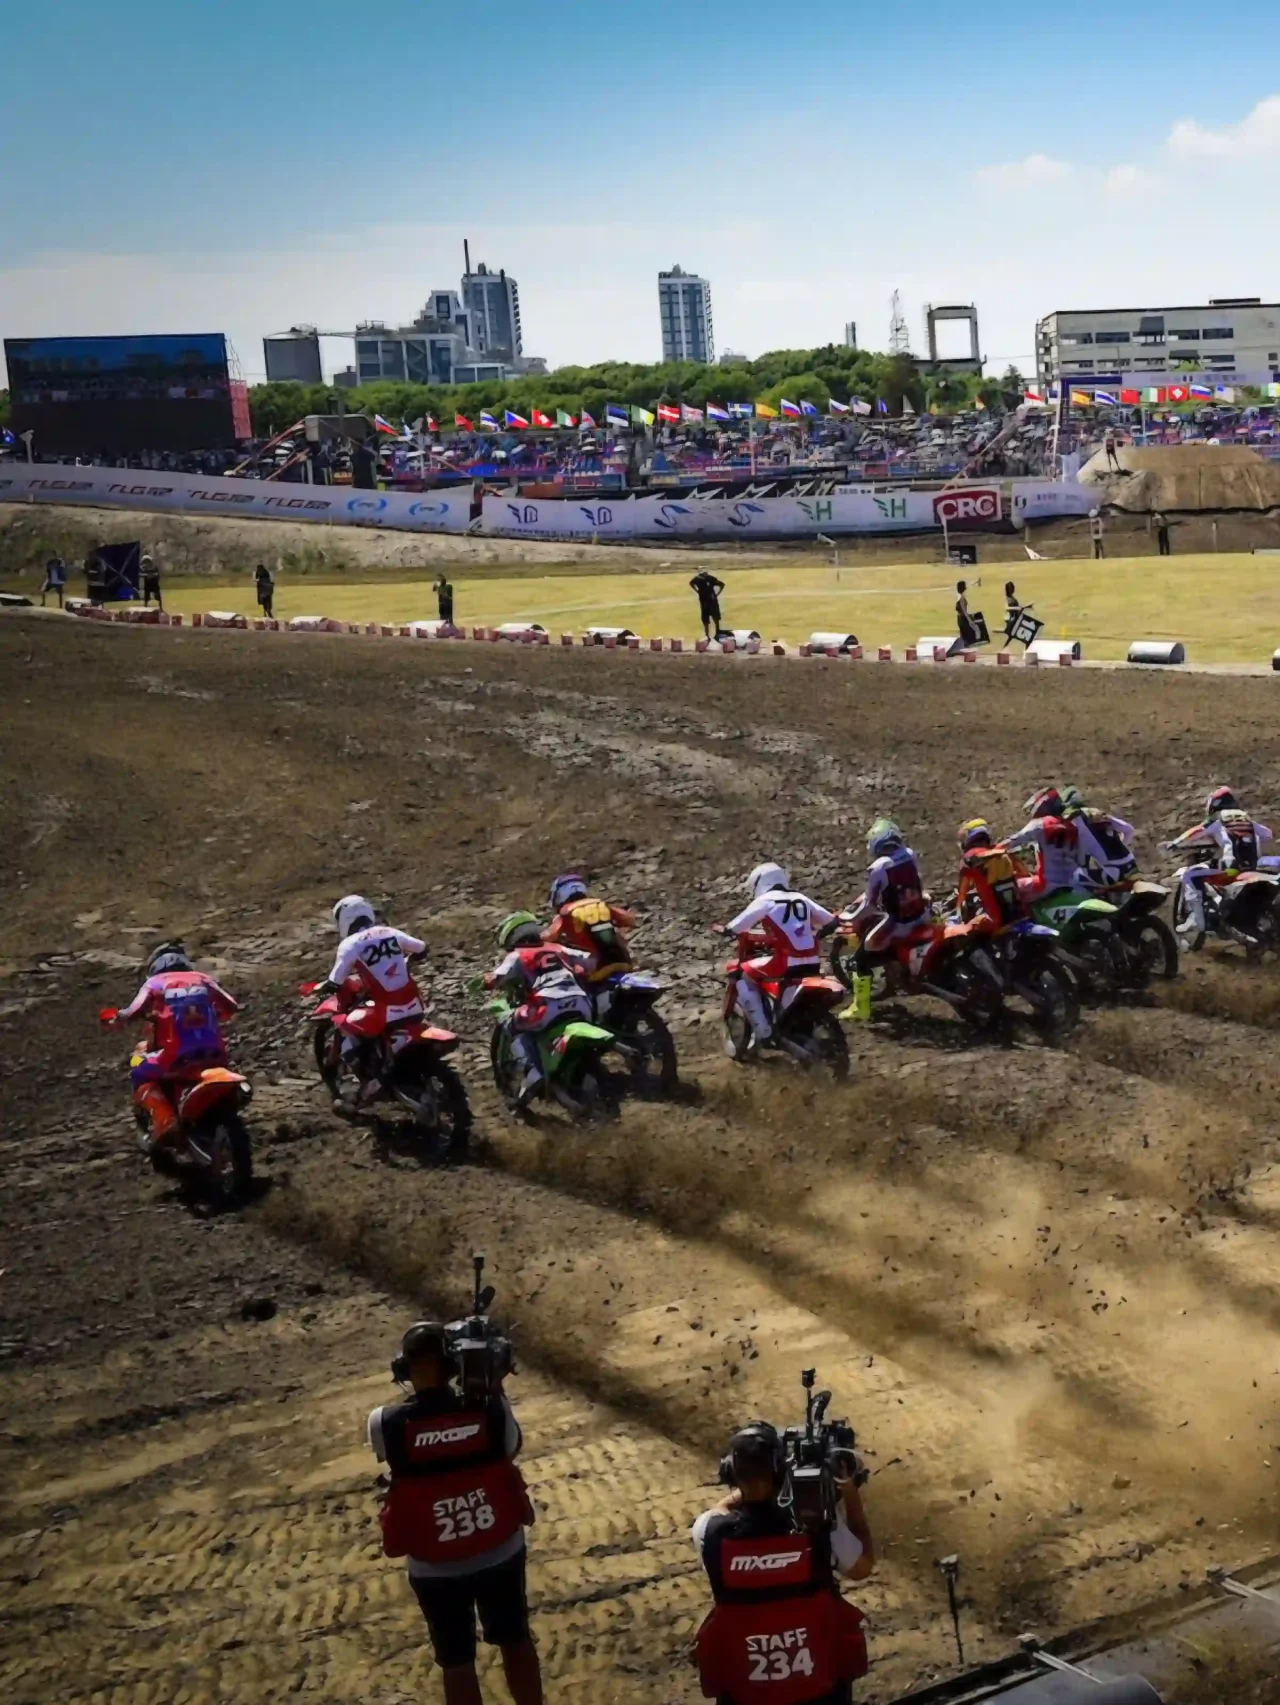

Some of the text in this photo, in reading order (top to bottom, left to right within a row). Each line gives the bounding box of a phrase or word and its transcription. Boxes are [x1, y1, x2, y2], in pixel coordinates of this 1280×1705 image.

[936, 495, 995, 520] CRC
[774, 898, 808, 924] 70
[362, 935, 402, 967] 243
[432, 1487, 486, 1518] STAFF
[435, 1504, 496, 1542] 238
[745, 1627, 808, 1652] STAFF
[748, 1647, 814, 1681] 234
